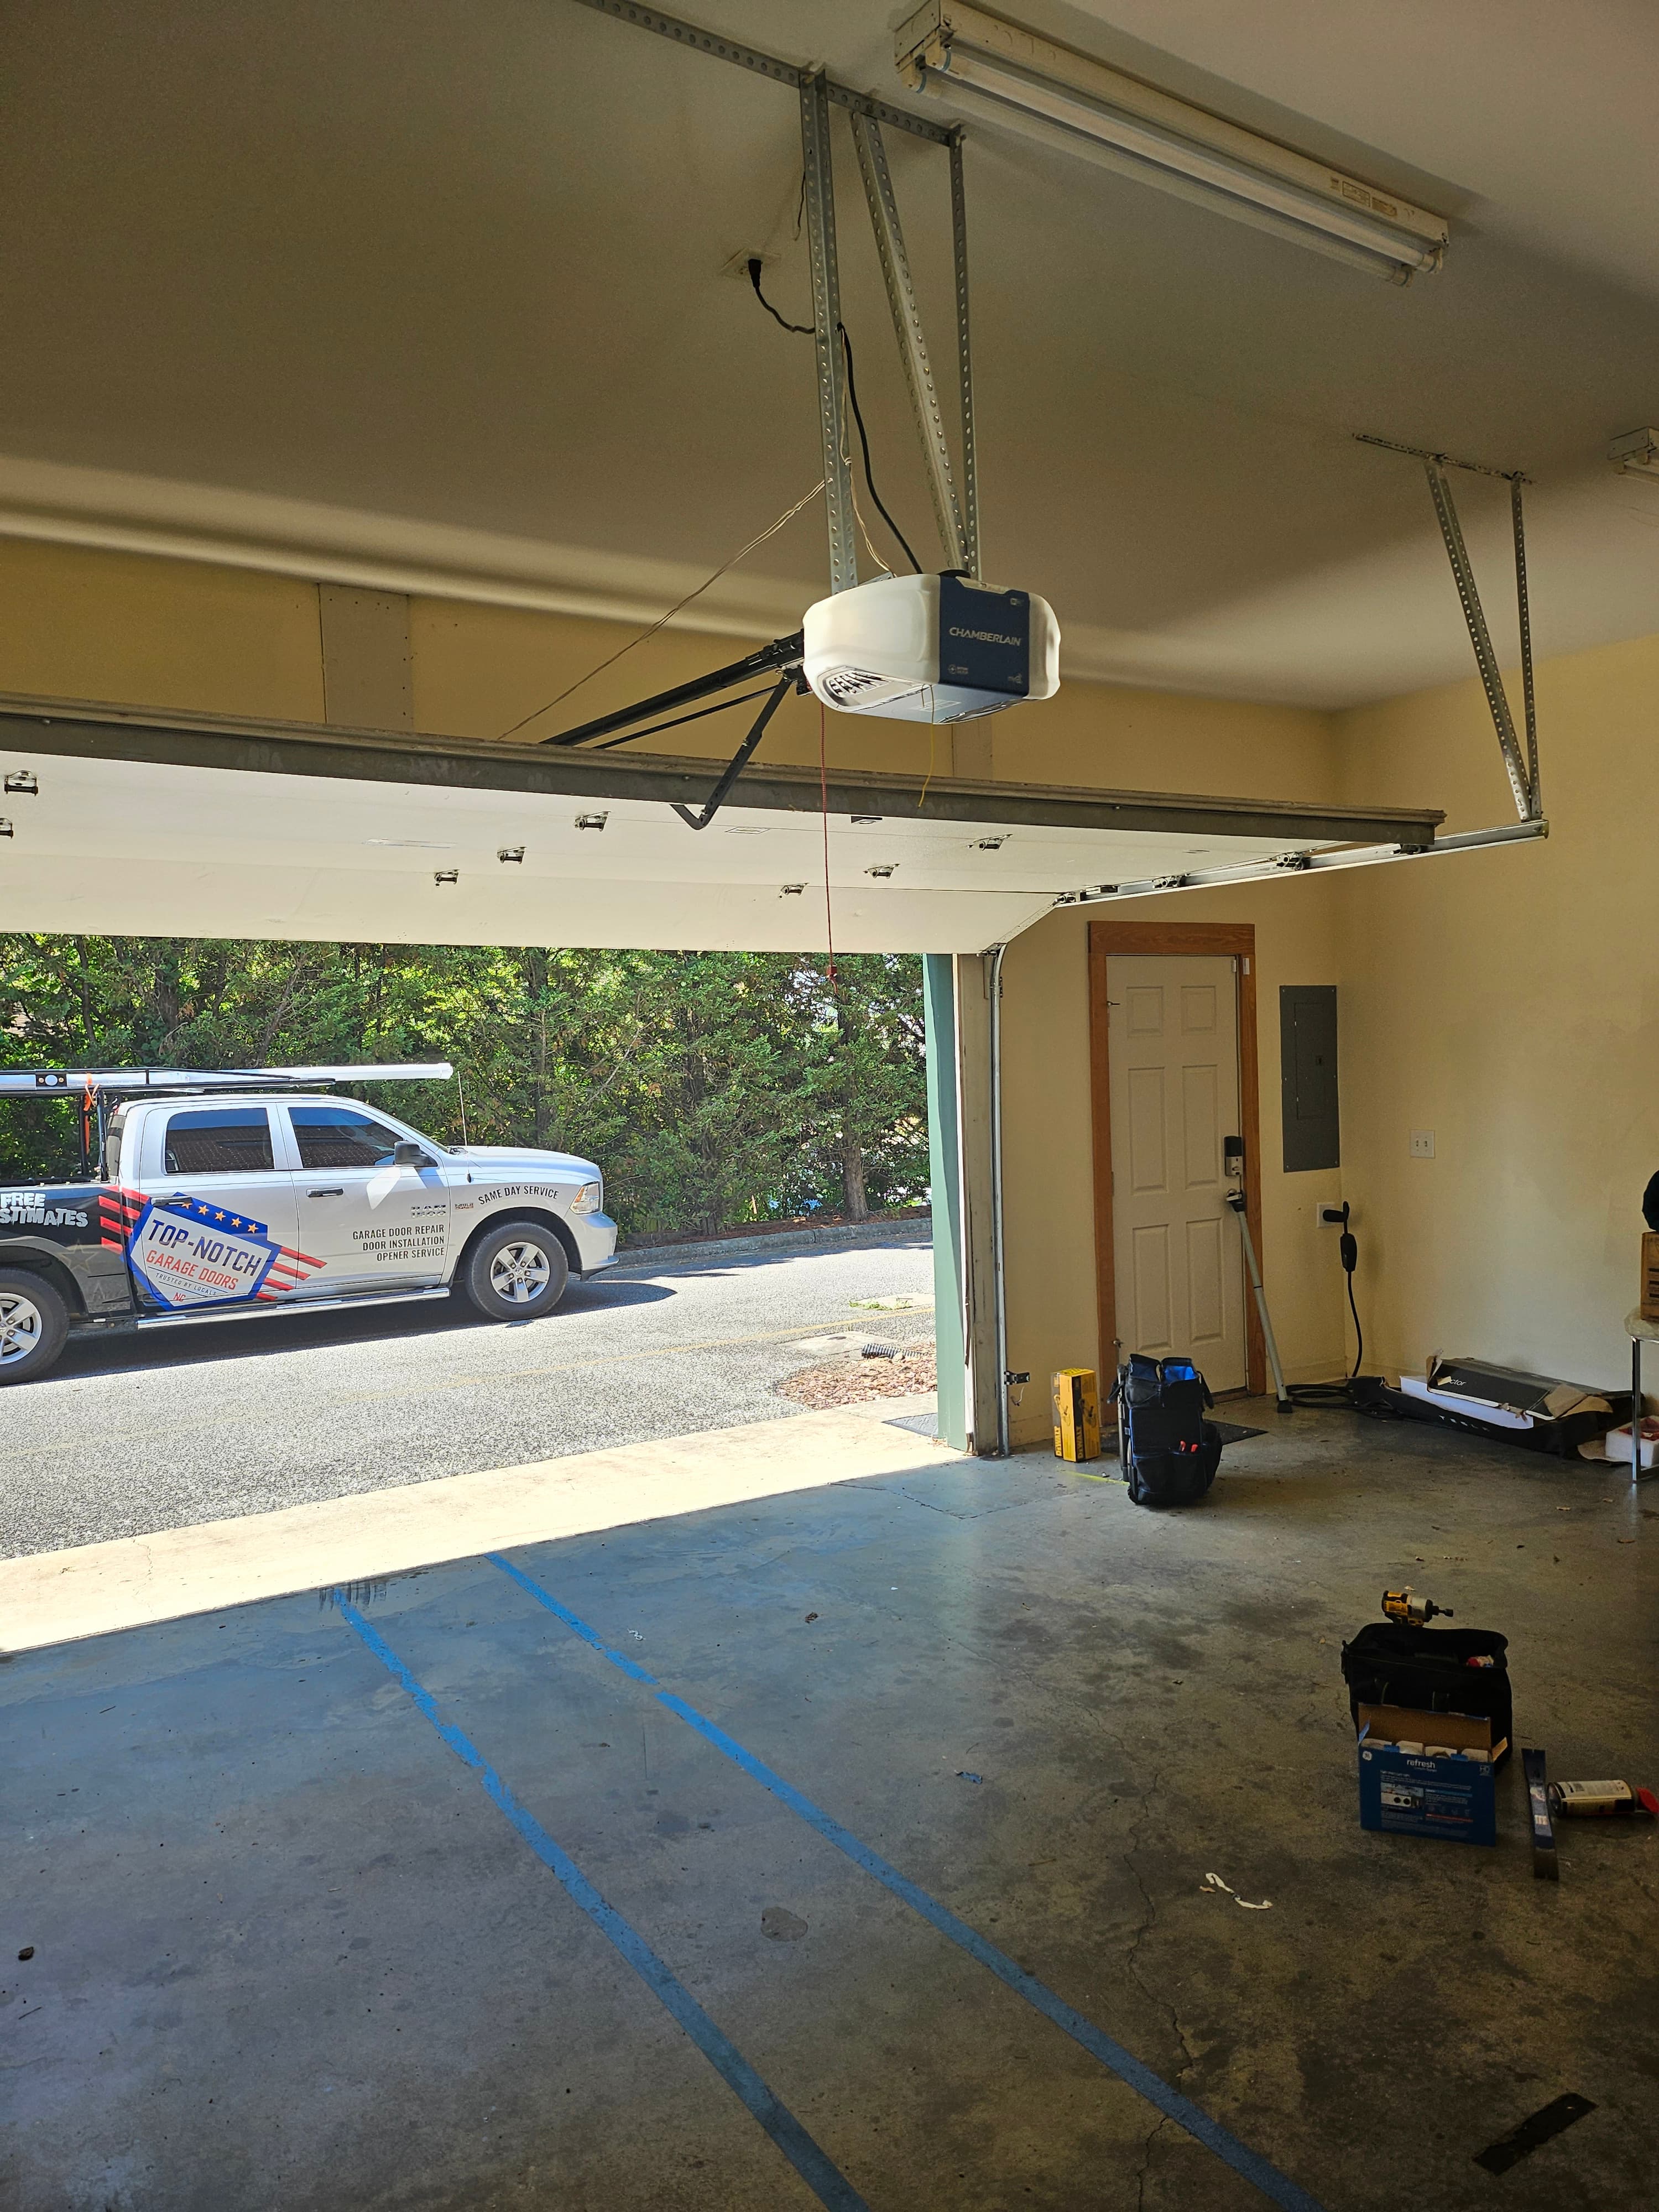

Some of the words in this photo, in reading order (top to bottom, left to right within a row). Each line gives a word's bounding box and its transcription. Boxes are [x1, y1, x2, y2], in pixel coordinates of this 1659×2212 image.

[949, 627, 1021, 646] CHAMBERLAIN
[1, 1192, 46, 1208] FREE
[478, 1189, 503, 1204] SAME
[504, 1186, 520, 1196] DAY
[524, 1186, 559, 1199] SERVICE
[353, 1229, 386, 1240] GARAGE
[389, 1227, 412, 1237] DOOR
[415, 1224, 444, 1234] REPAIR
[148, 1219, 262, 1276] TOP-NOTCH
[363, 1241, 386, 1250] DOOR
[389, 1236, 444, 1248] INSTALLATION
[377, 1251, 408, 1261] OPENER
[412, 1248, 445, 1258] SERVICE
[146, 1250, 199, 1277] GARAGE
[199, 1267, 239, 1290] DOORS
[155, 1273, 181, 1285] TRUSTED
[194, 1285, 217, 1296] LOCALS
[173, 1292, 186, 1302] NC
[1406, 1759, 1436, 1769] refresh
